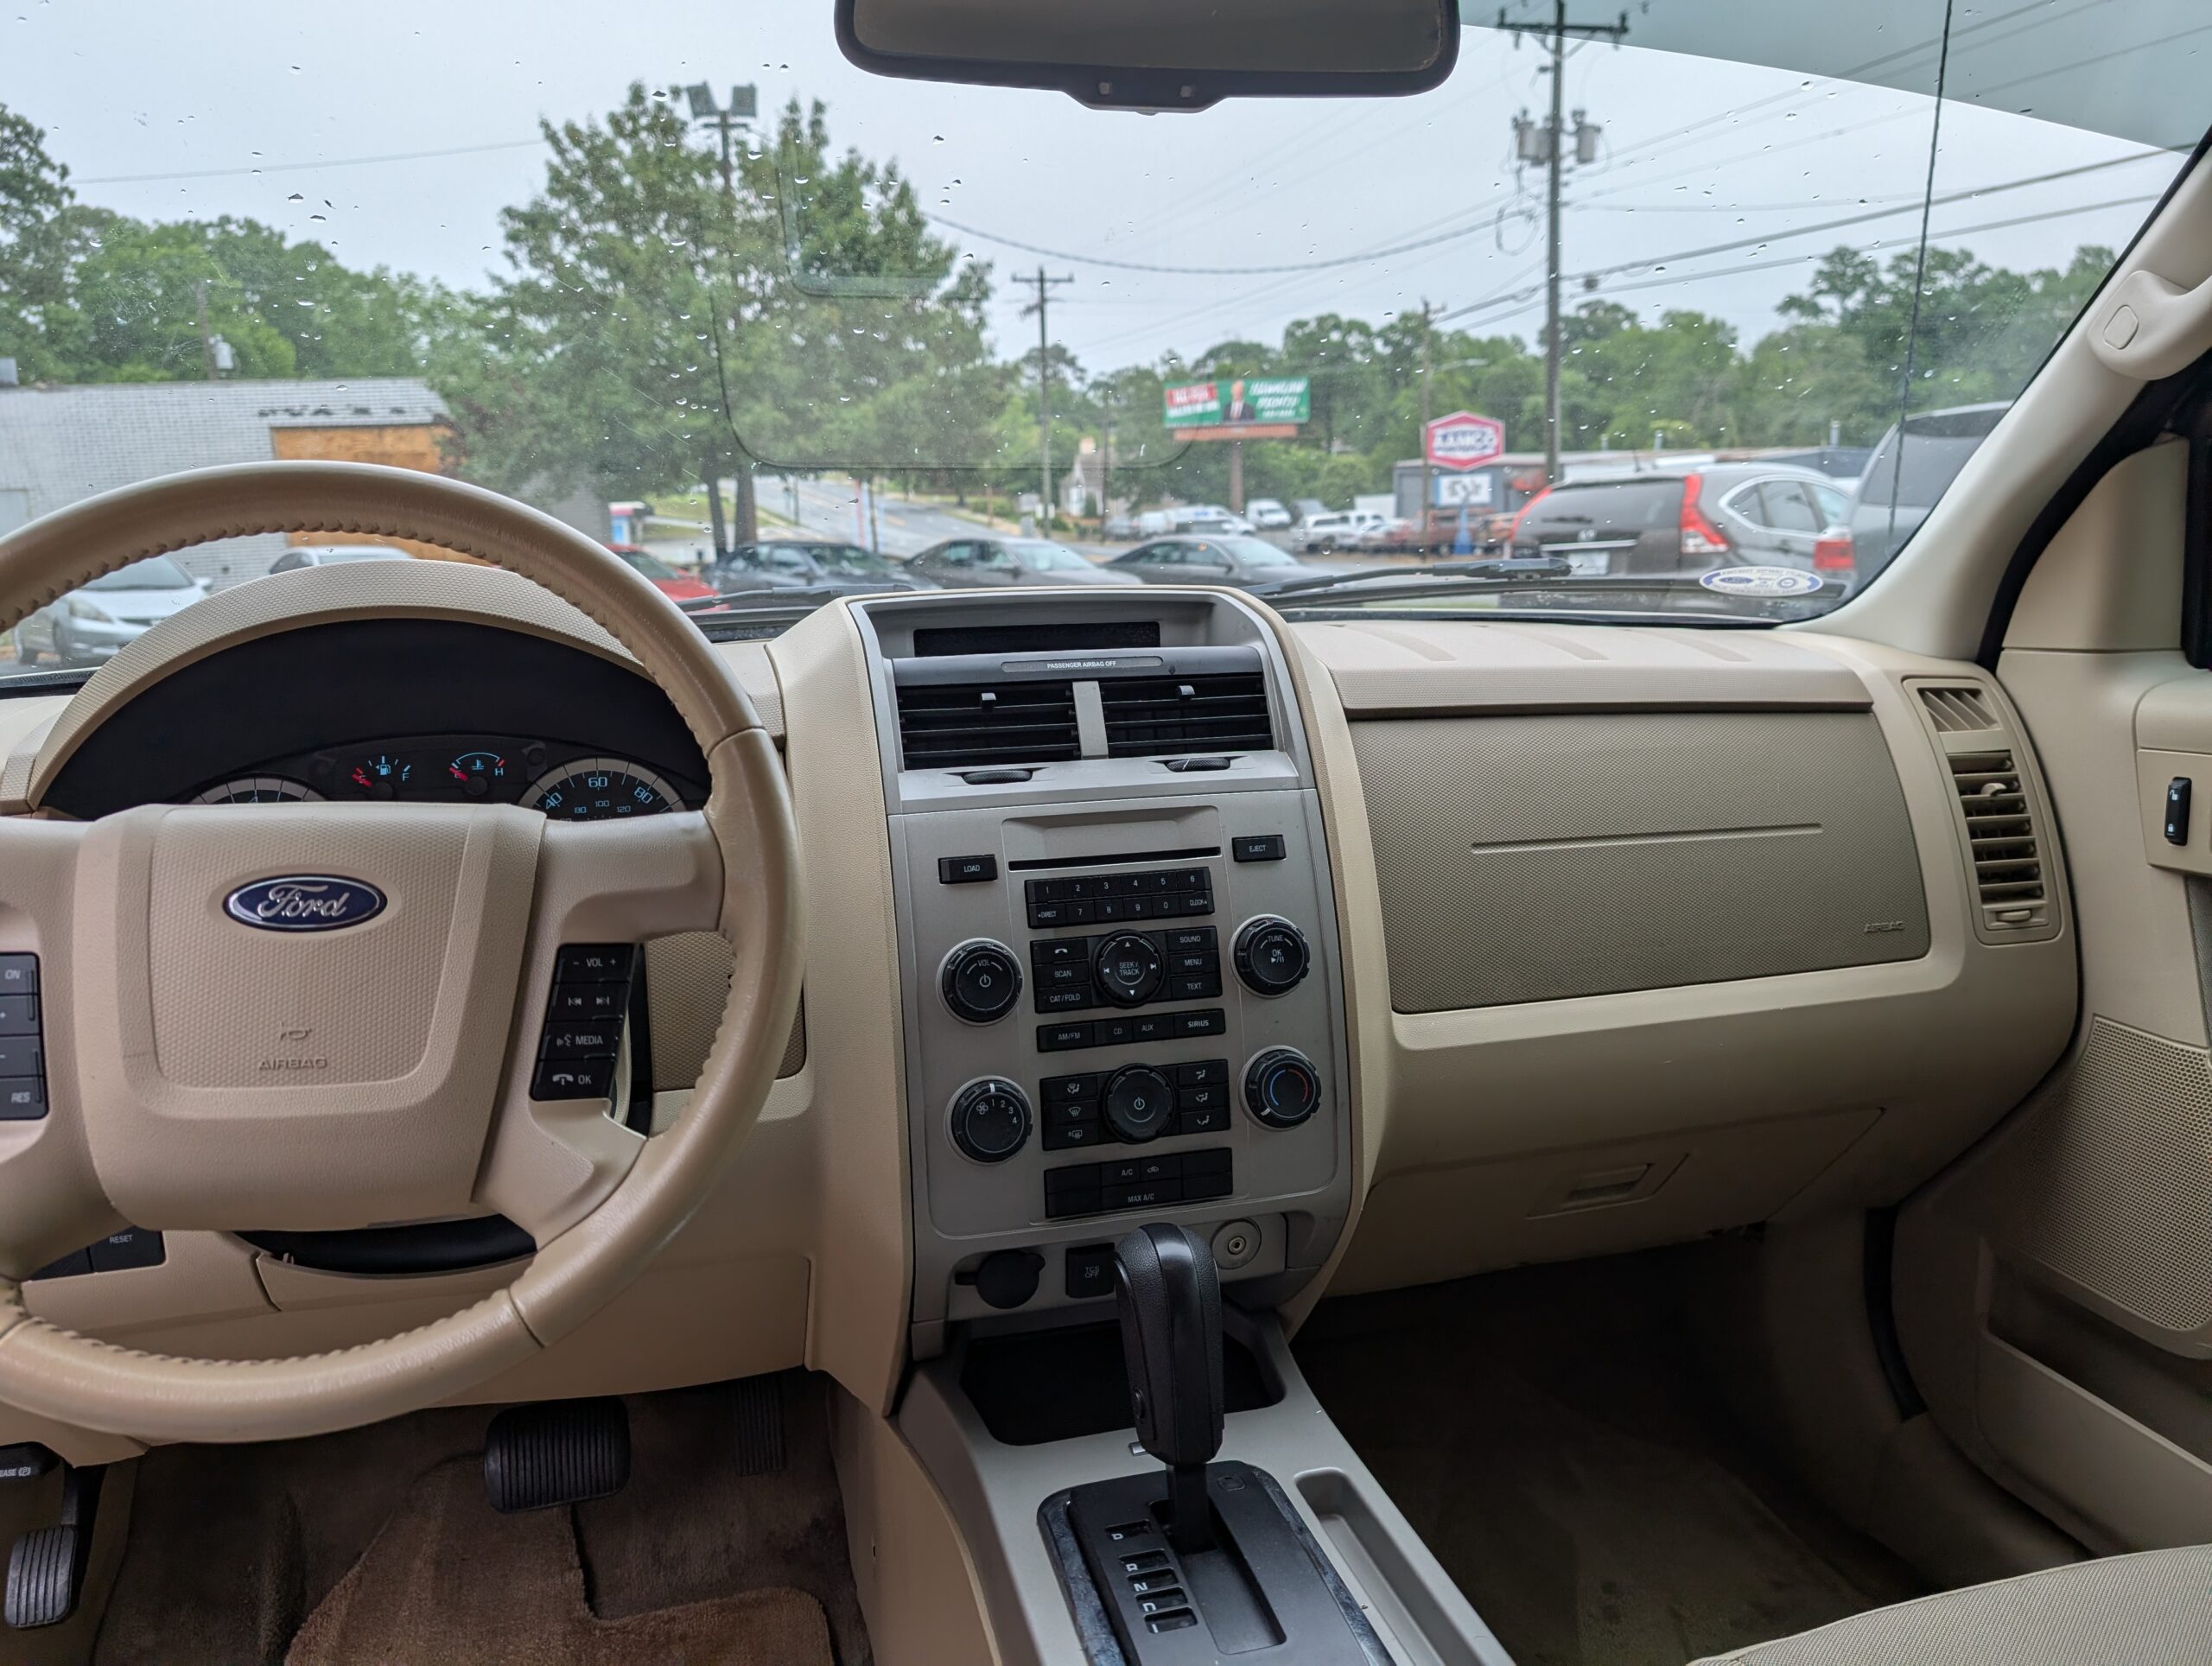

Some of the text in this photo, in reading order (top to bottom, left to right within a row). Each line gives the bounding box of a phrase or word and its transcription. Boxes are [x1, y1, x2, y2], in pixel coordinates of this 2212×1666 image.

[494, 767, 504, 776] H
[402, 773, 410, 781] F
[588, 776, 608, 788] 60
[633, 786, 654, 804] 80
[545, 792, 563, 810] 40
[1249, 844, 1266, 853] EJECT
[257, 884, 350, 918] Ford
[1179, 935, 1201, 944] SOUND
[586, 958, 603, 967] VOL
[5, 970, 21, 980] ON
[1188, 1020, 1210, 1028] SIRIUS
[575, 1035, 603, 1046] MEDIA
[1058, 1032, 1081, 1041] AM/FM
[259, 1056, 327, 1071] AIRBAG
[578, 1074, 592, 1085] OK
[11, 1091, 30, 1103] RES
[1128, 1194, 1141, 1203] MAX
[109, 1234, 133, 1243] RESET
[1125, 1562, 1138, 1572] R
[1133, 1582, 1148, 1592] N
